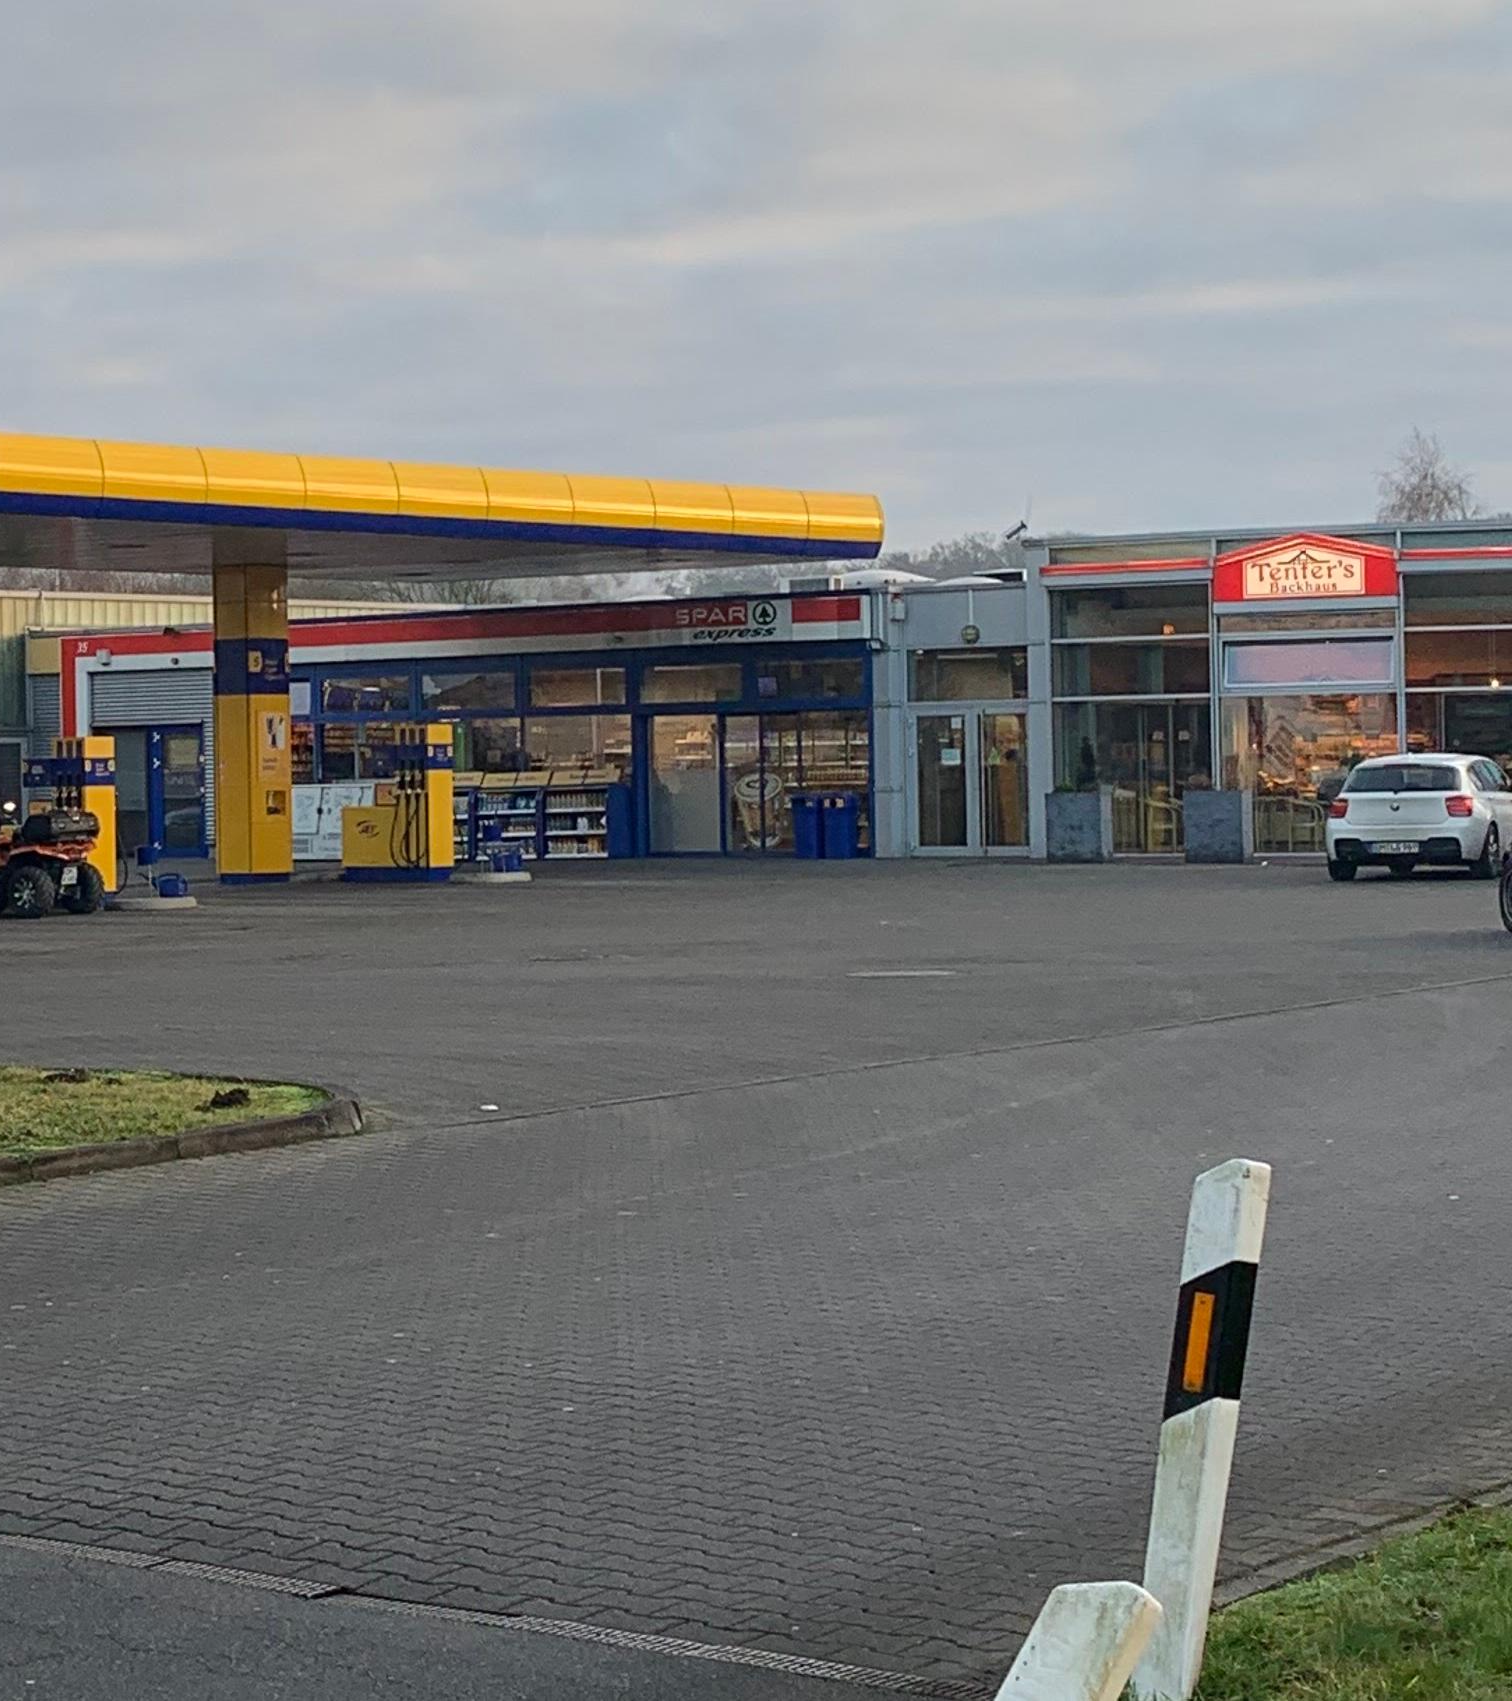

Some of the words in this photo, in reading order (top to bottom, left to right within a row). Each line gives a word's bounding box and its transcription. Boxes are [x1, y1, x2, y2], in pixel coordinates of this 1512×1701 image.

[1250, 560, 1355, 583] Tenter's
[1269, 581, 1338, 594] Backhaus
[675, 606, 746, 625] SPAR
[692, 626, 777, 642] express
